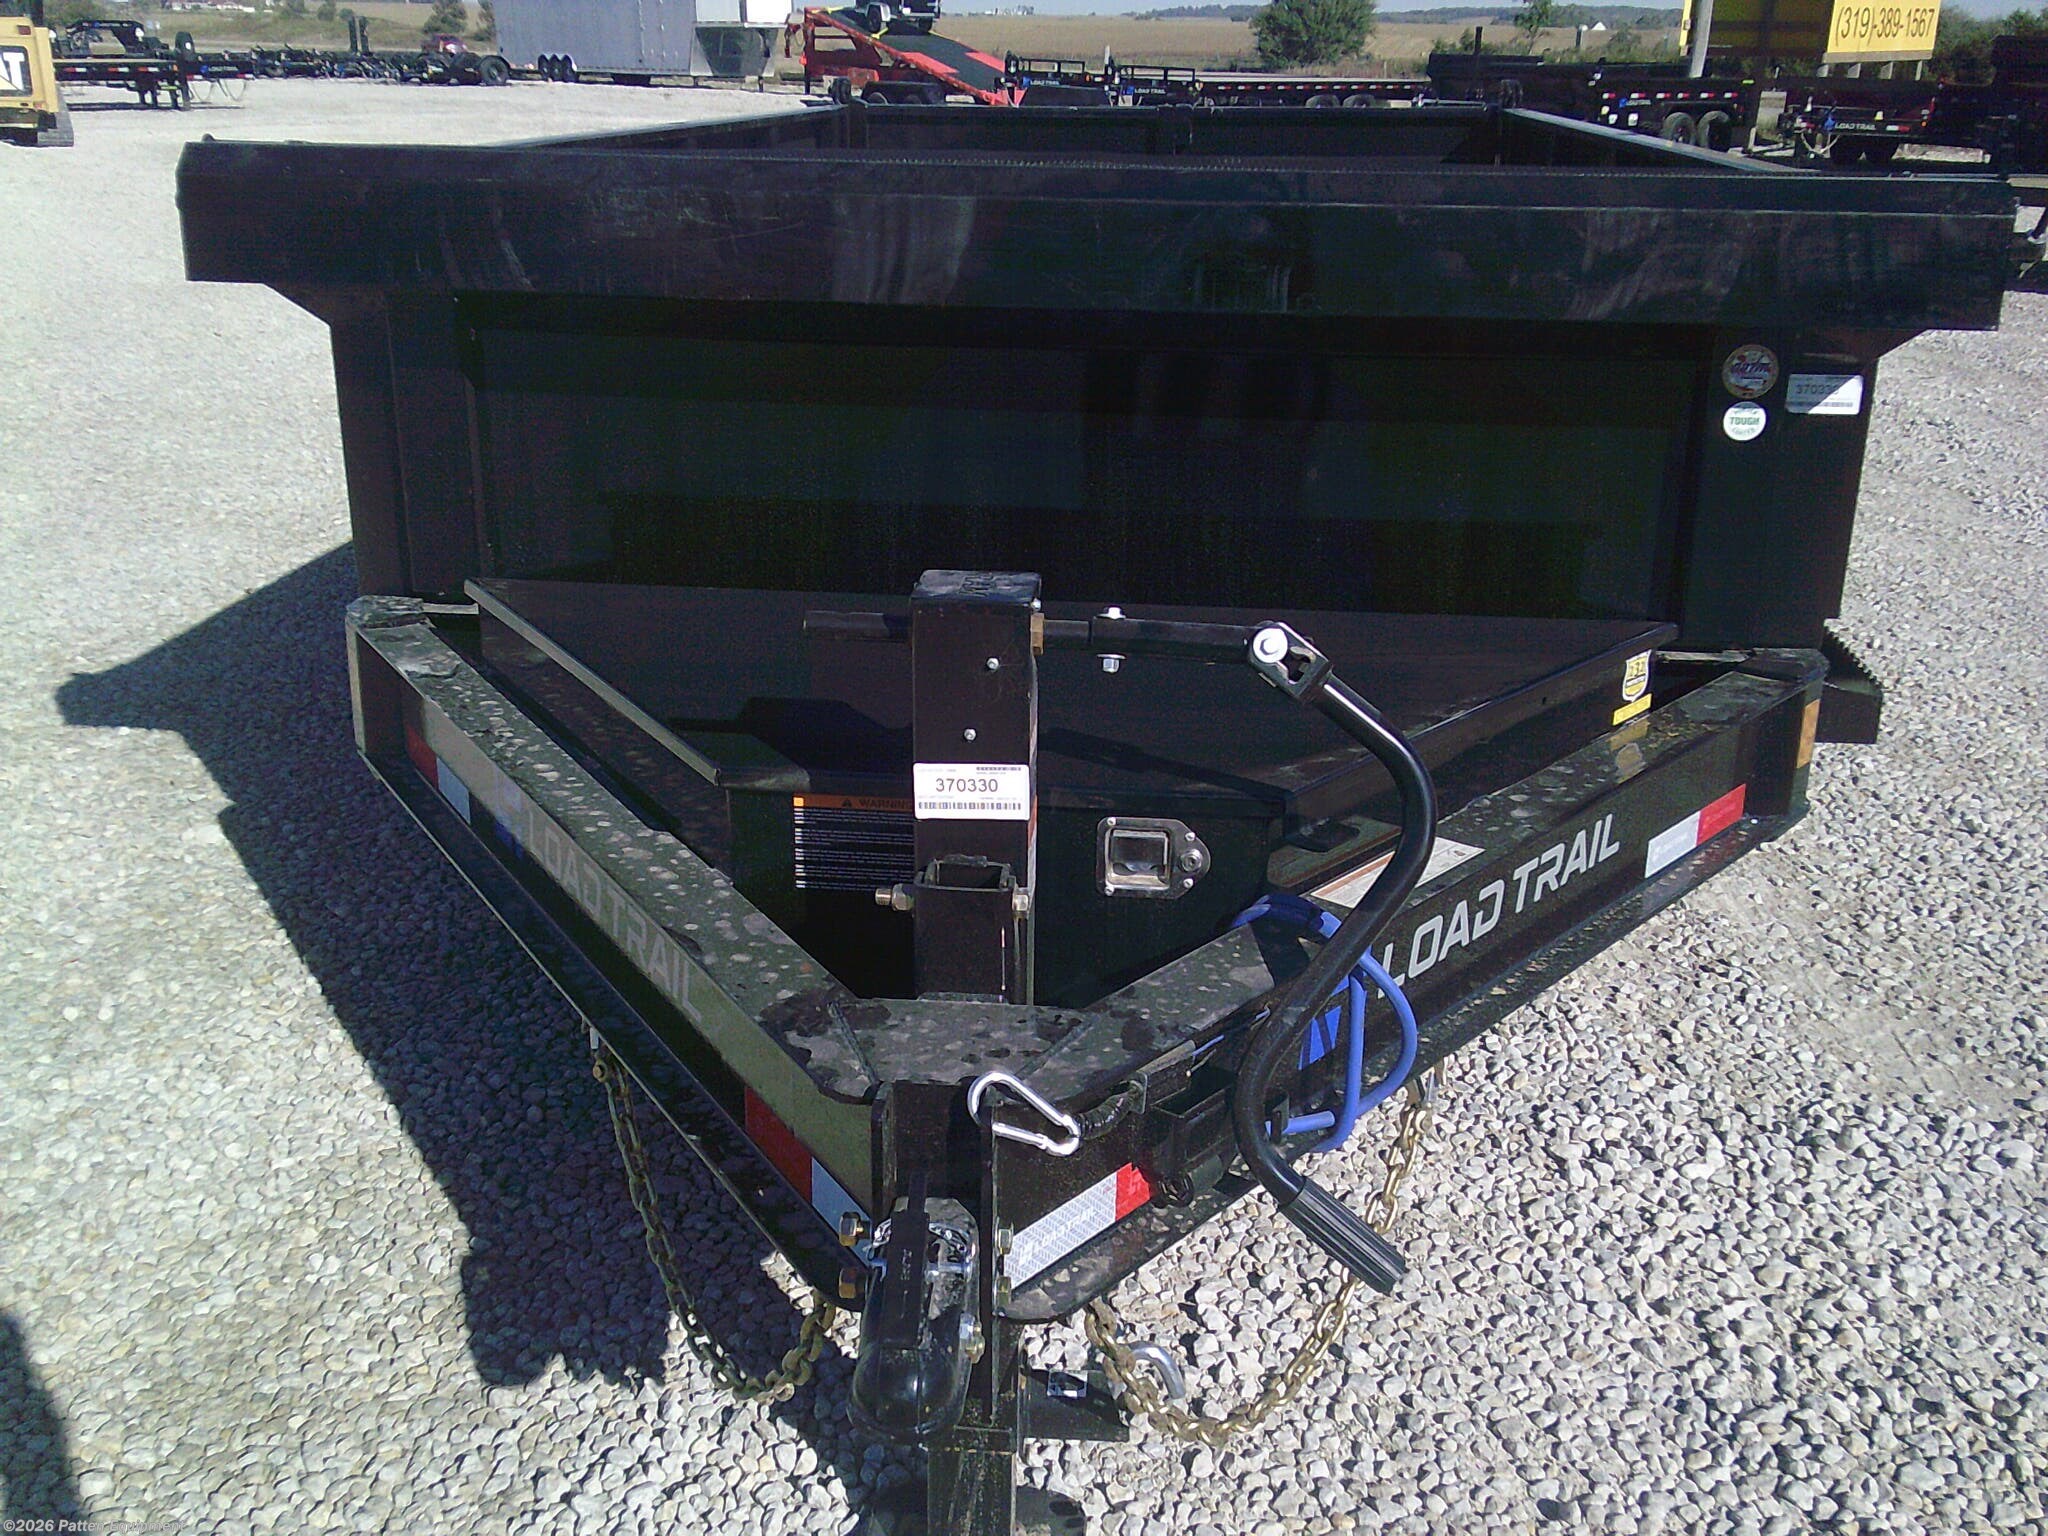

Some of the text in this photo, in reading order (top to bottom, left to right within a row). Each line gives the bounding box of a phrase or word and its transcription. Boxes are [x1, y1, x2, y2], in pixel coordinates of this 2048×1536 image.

[1836, 6, 1935, 46] (319)-389-1567
[1730, 416, 1760, 425] TOUGH
[935, 778, 999, 792] 370330
[528, 810, 702, 1022] LOAD TRAIL
[1377, 879, 1505, 999] LOAD
[1514, 813, 1620, 914] TRAIL
